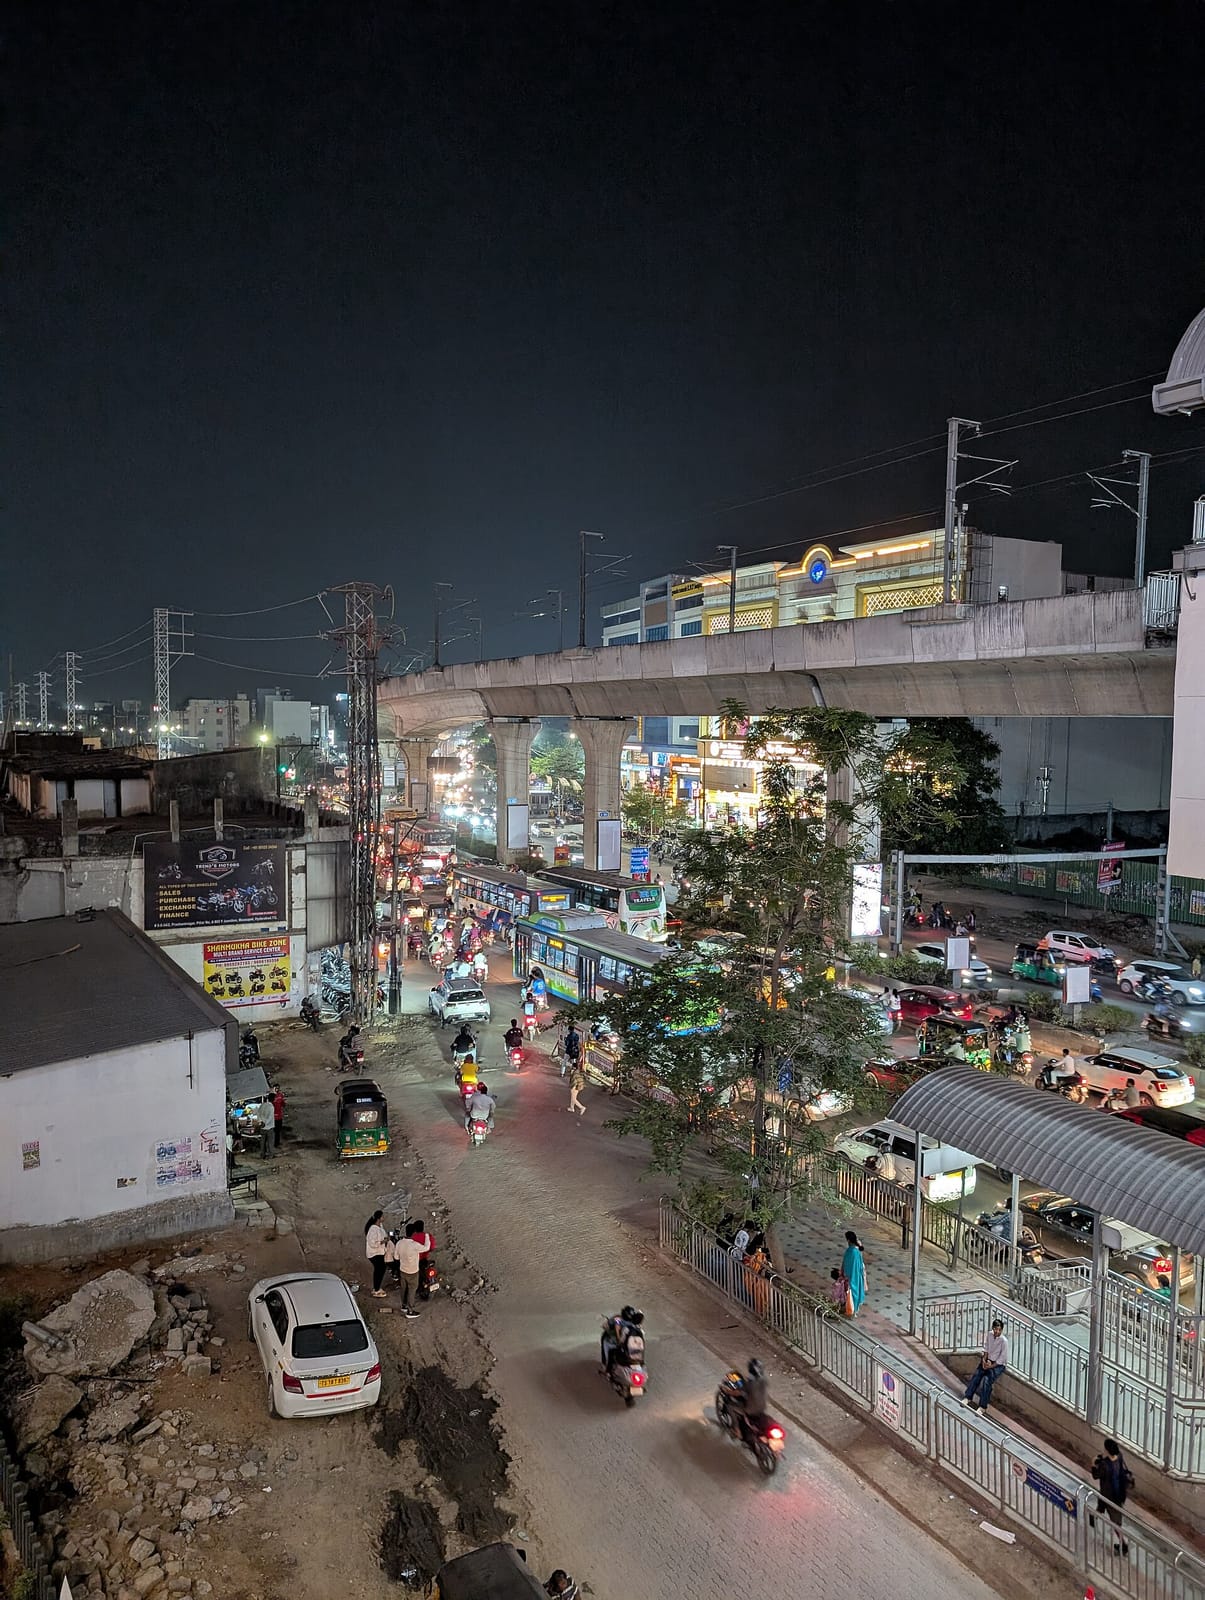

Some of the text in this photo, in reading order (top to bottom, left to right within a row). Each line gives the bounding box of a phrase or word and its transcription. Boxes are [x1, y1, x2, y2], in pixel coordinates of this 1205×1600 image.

[159, 896, 196, 904] PURCHASE
[159, 903, 197, 911] EXCHANGE
[159, 911, 190, 919] FINANCE
[207, 939, 287, 952] SHANMUKHA BIKE ZONE
